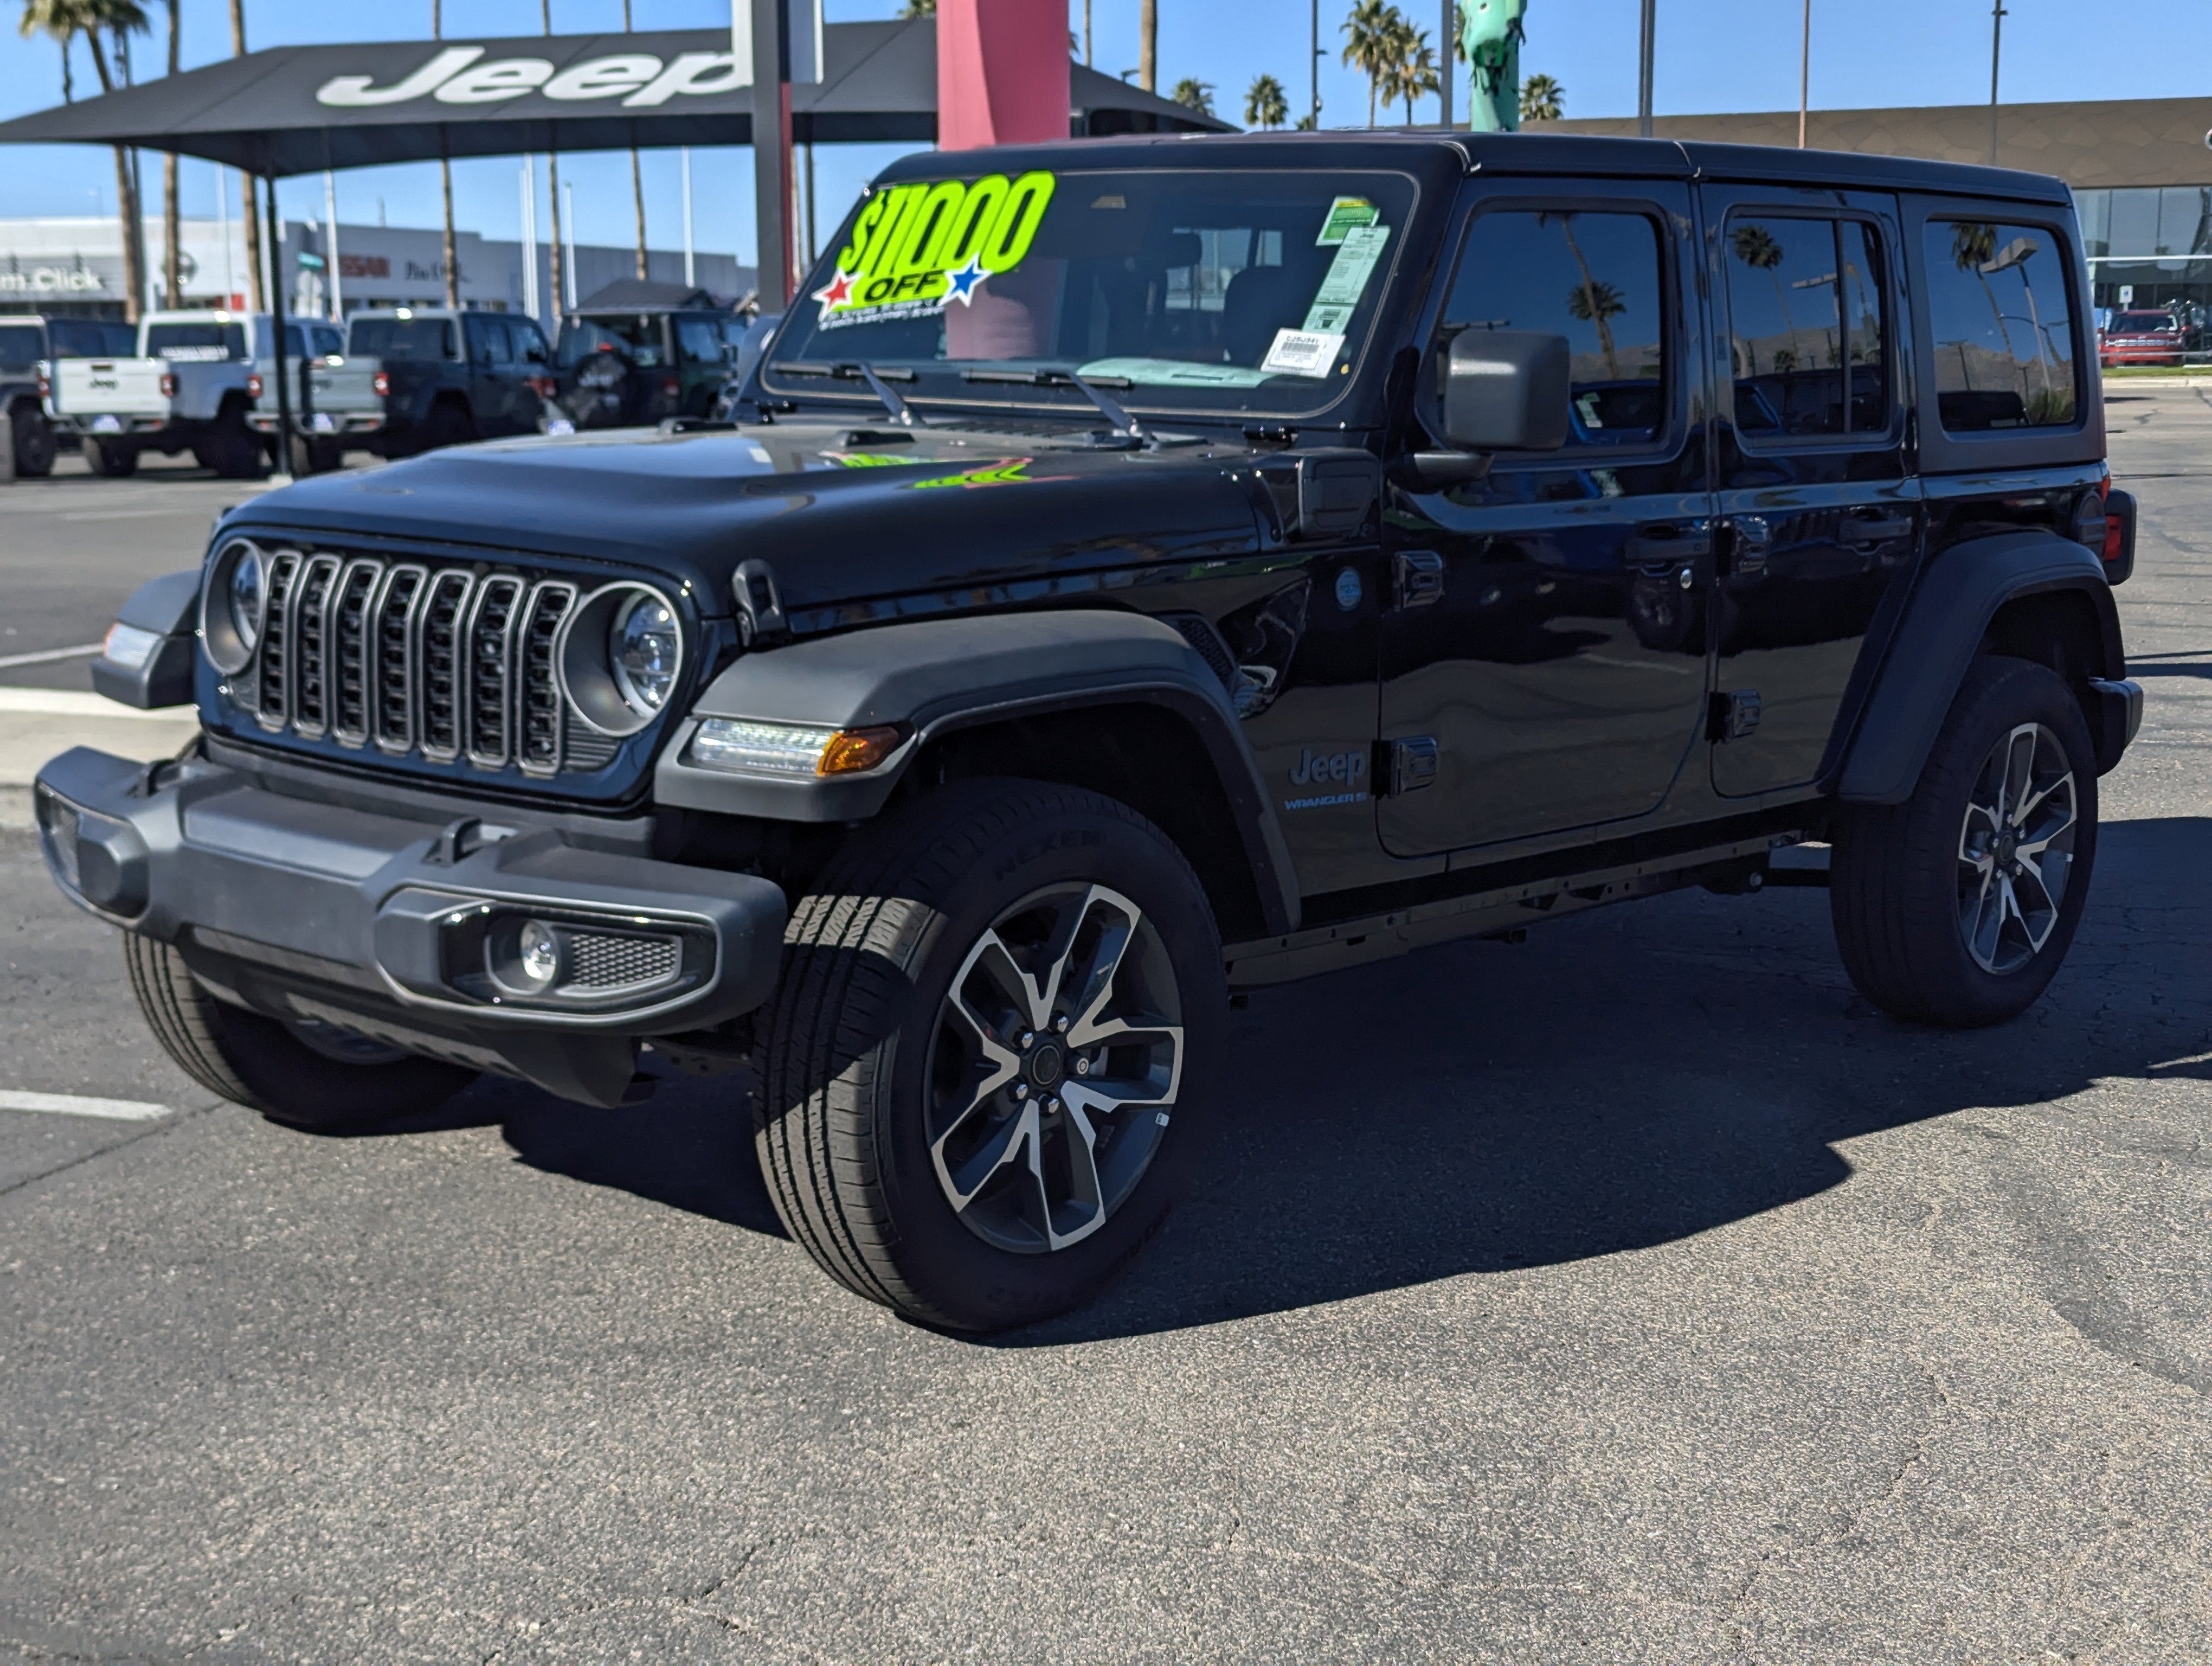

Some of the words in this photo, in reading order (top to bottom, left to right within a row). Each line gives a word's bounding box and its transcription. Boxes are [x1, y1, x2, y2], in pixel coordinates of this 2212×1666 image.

[316, 45, 753, 107] Jeep
[34, 266, 102, 291] Click
[864, 269, 945, 300] OFF
[1288, 748, 1367, 786] Jeep
[1283, 793, 1354, 810] WRANGLER
